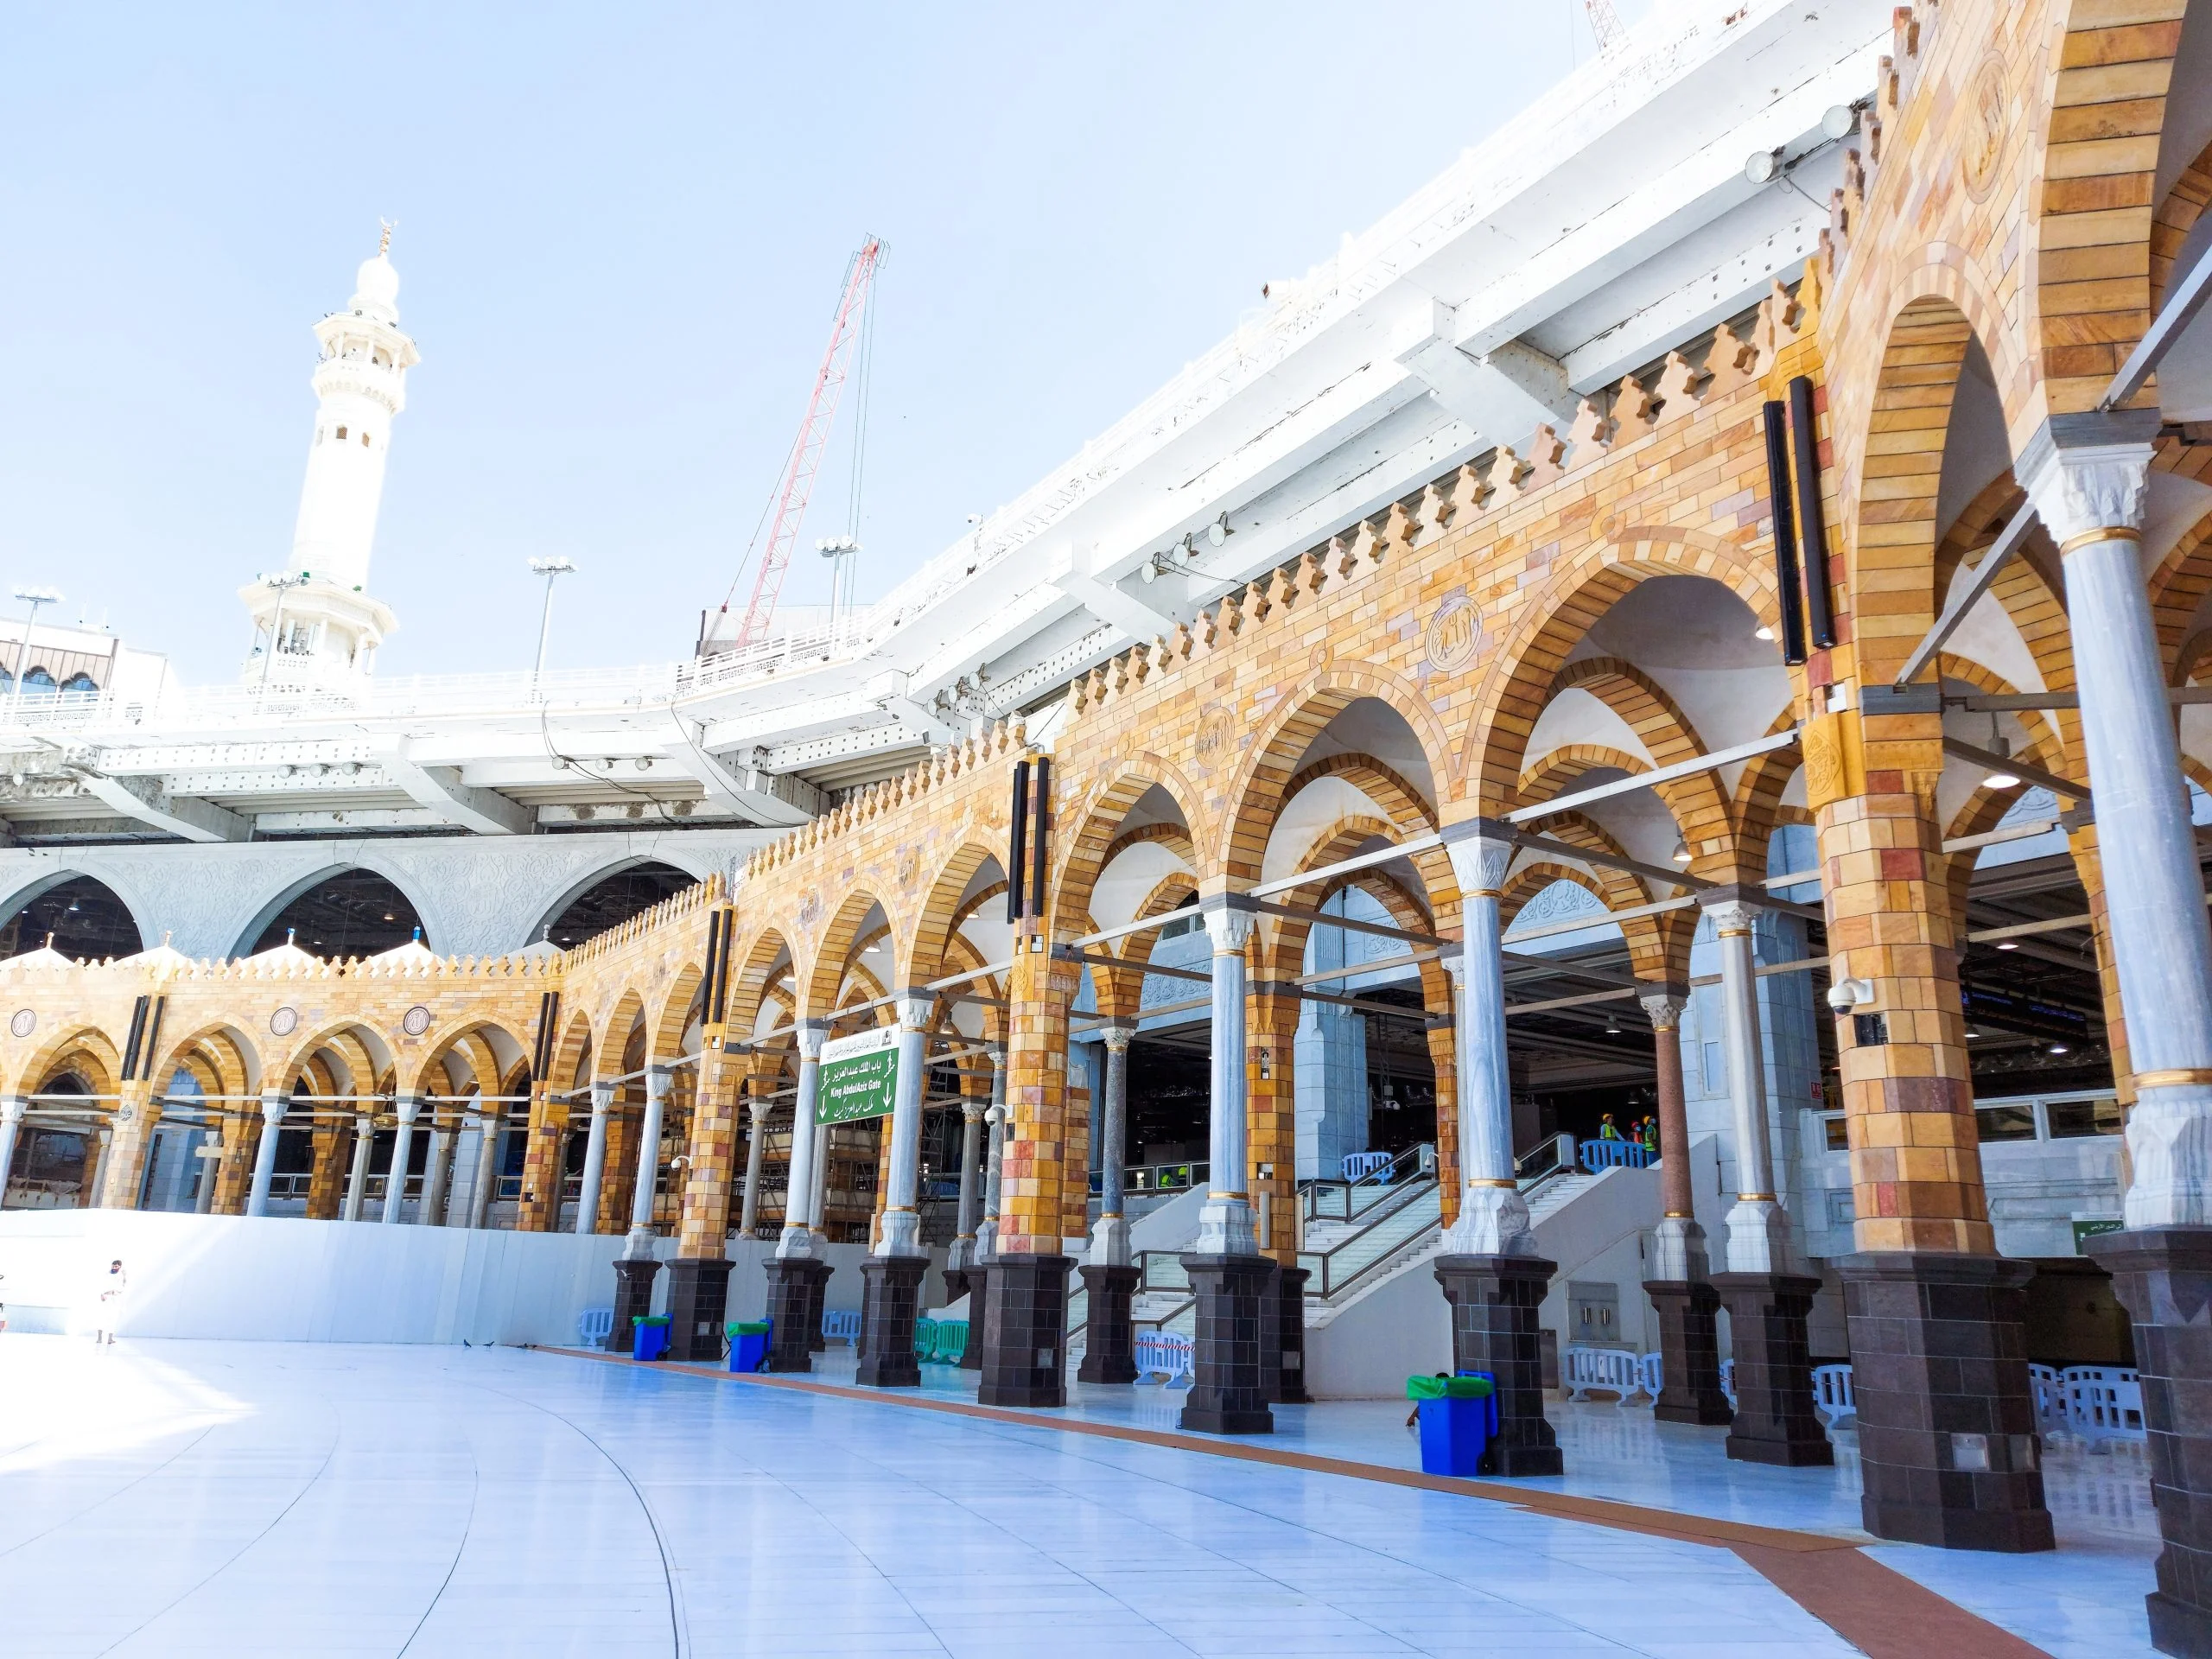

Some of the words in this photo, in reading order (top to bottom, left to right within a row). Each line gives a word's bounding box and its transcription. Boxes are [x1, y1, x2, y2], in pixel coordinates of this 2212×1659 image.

[859, 1060, 871, 1073] الملك
[872, 1058, 881, 1074] باب
[830, 1087, 842, 1098] King
[842, 1081, 868, 1096] AbdulAziz
[868, 1079, 881, 1090] Gate
